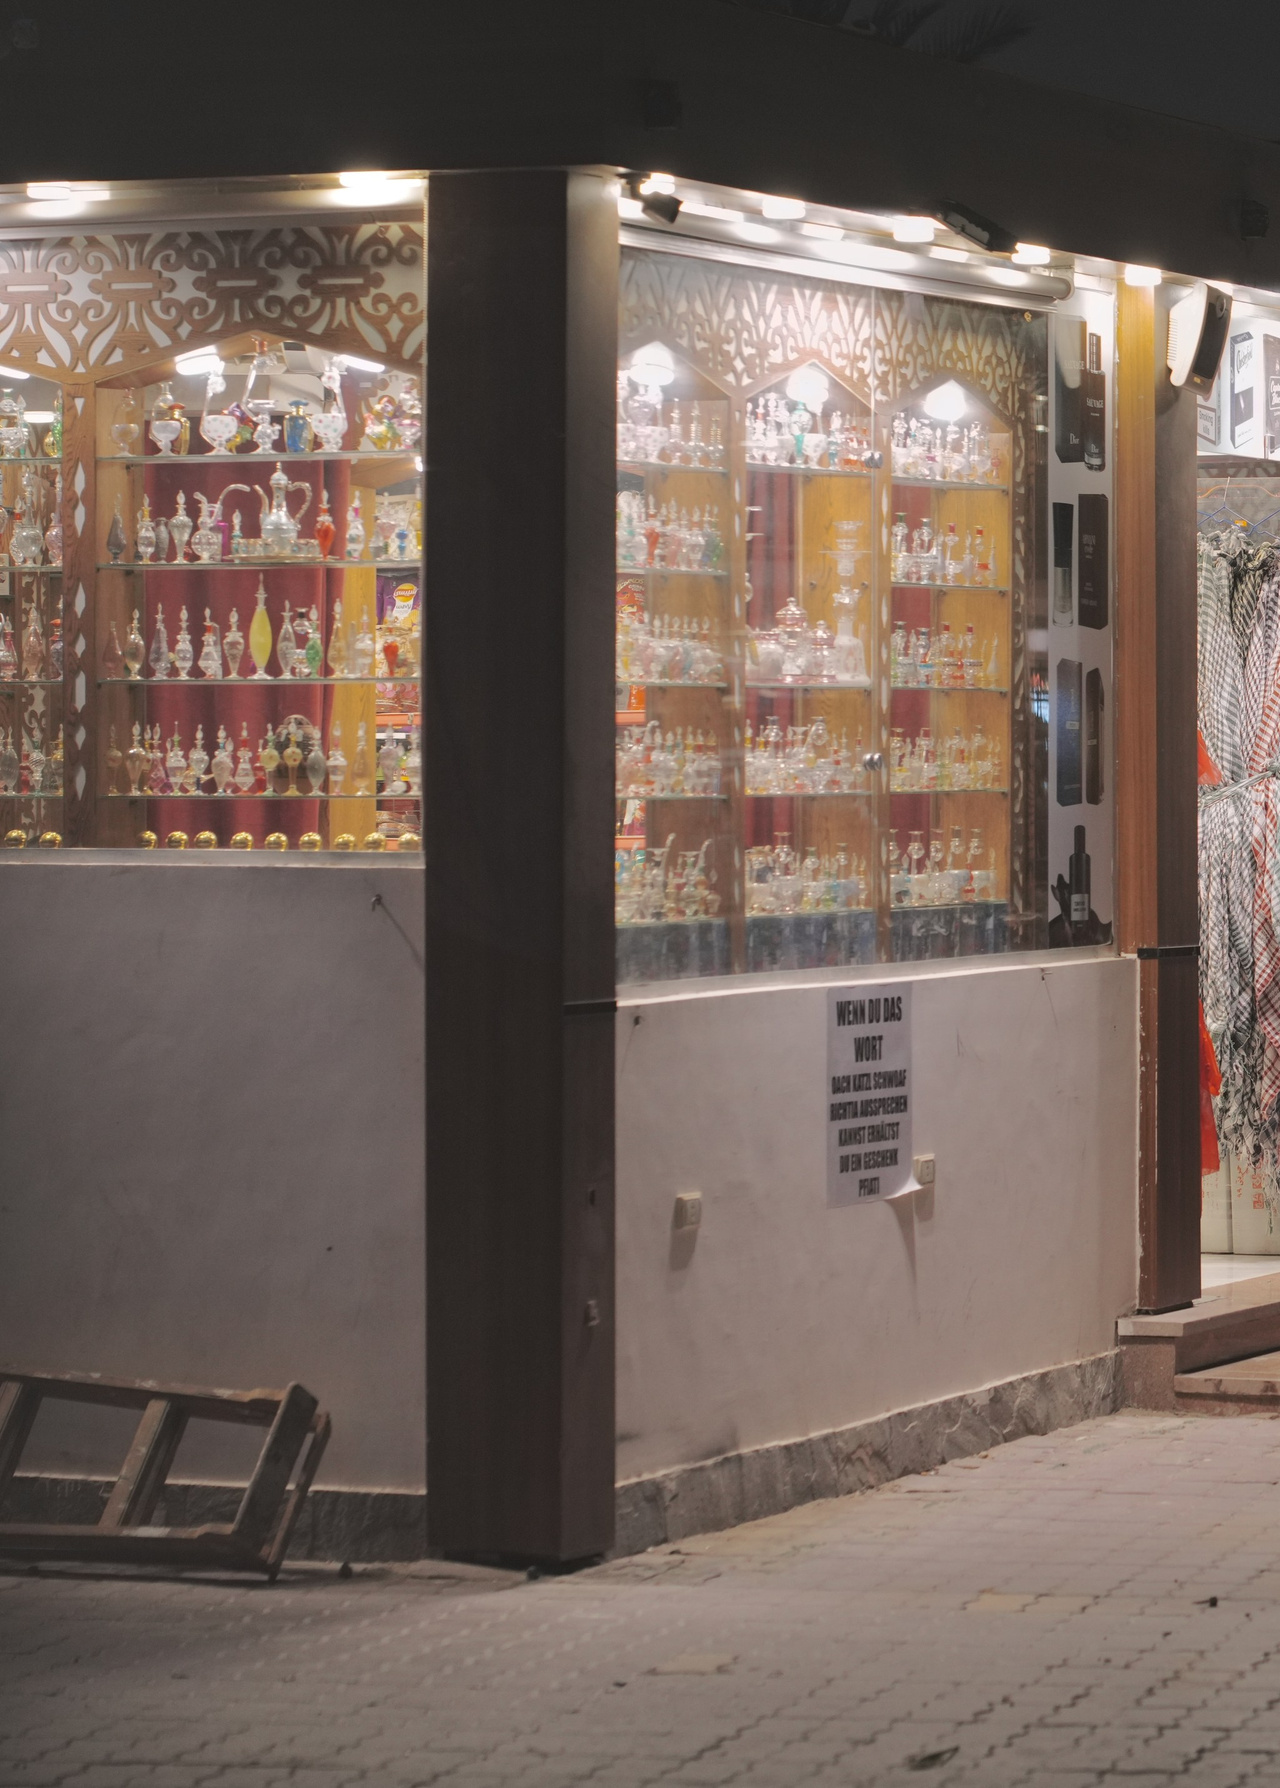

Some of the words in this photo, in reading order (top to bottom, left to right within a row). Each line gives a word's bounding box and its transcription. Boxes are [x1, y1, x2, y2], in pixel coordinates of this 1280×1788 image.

[1199, 410, 1213, 426] Smoking
[1069, 433, 1079, 444] Dior
[836, 1000, 866, 1027] WENN
[868, 998, 881, 1024] DU
[883, 996, 902, 1023] DAS
[854, 1035, 883, 1063] WORT
[852, 1073, 872, 1092] KATZL
[873, 1069, 906, 1090] SCHWOAF
[859, 1095, 908, 1118] AUSSPRECHEN
[838, 1126, 866, 1147] KANNST
[867, 1121, 900, 1143] ERHÄLTST
[839, 1155, 850, 1174] DU
[850, 1153, 862, 1172] EIN
[863, 1148, 898, 1170] GESCHENK
